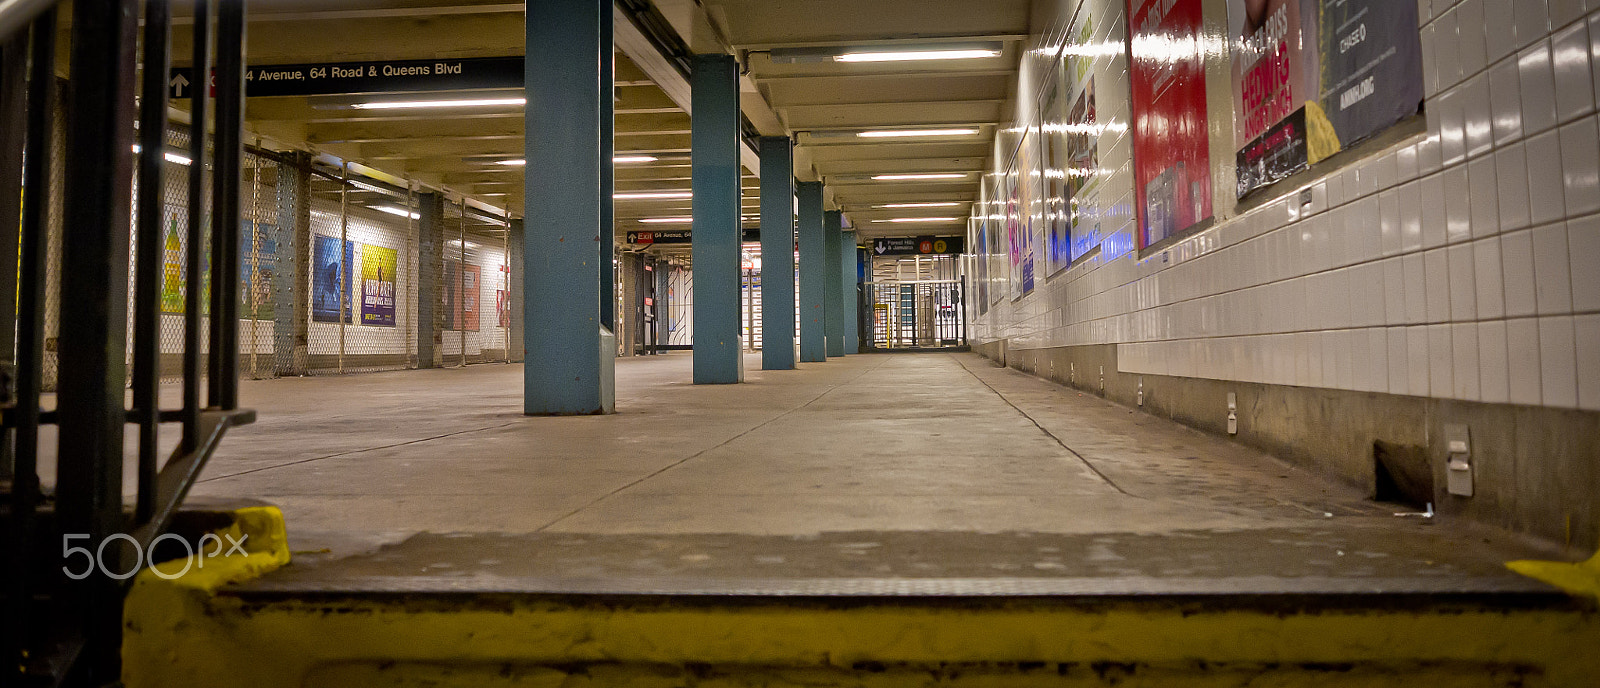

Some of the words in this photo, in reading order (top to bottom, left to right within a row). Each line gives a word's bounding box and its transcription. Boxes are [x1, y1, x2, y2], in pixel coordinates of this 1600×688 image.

[1340, 28, 1360, 54] CHASE
[258, 69, 306, 82] Avenue,
[309, 67, 327, 79] 64
[331, 66, 364, 78] Road
[368, 65, 378, 77] &
[382, 64, 430, 77] Queens
[434, 63, 462, 75] Blvd
[1241, 41, 1290, 116] HEDWIG
[637, 232, 652, 240] Exit
